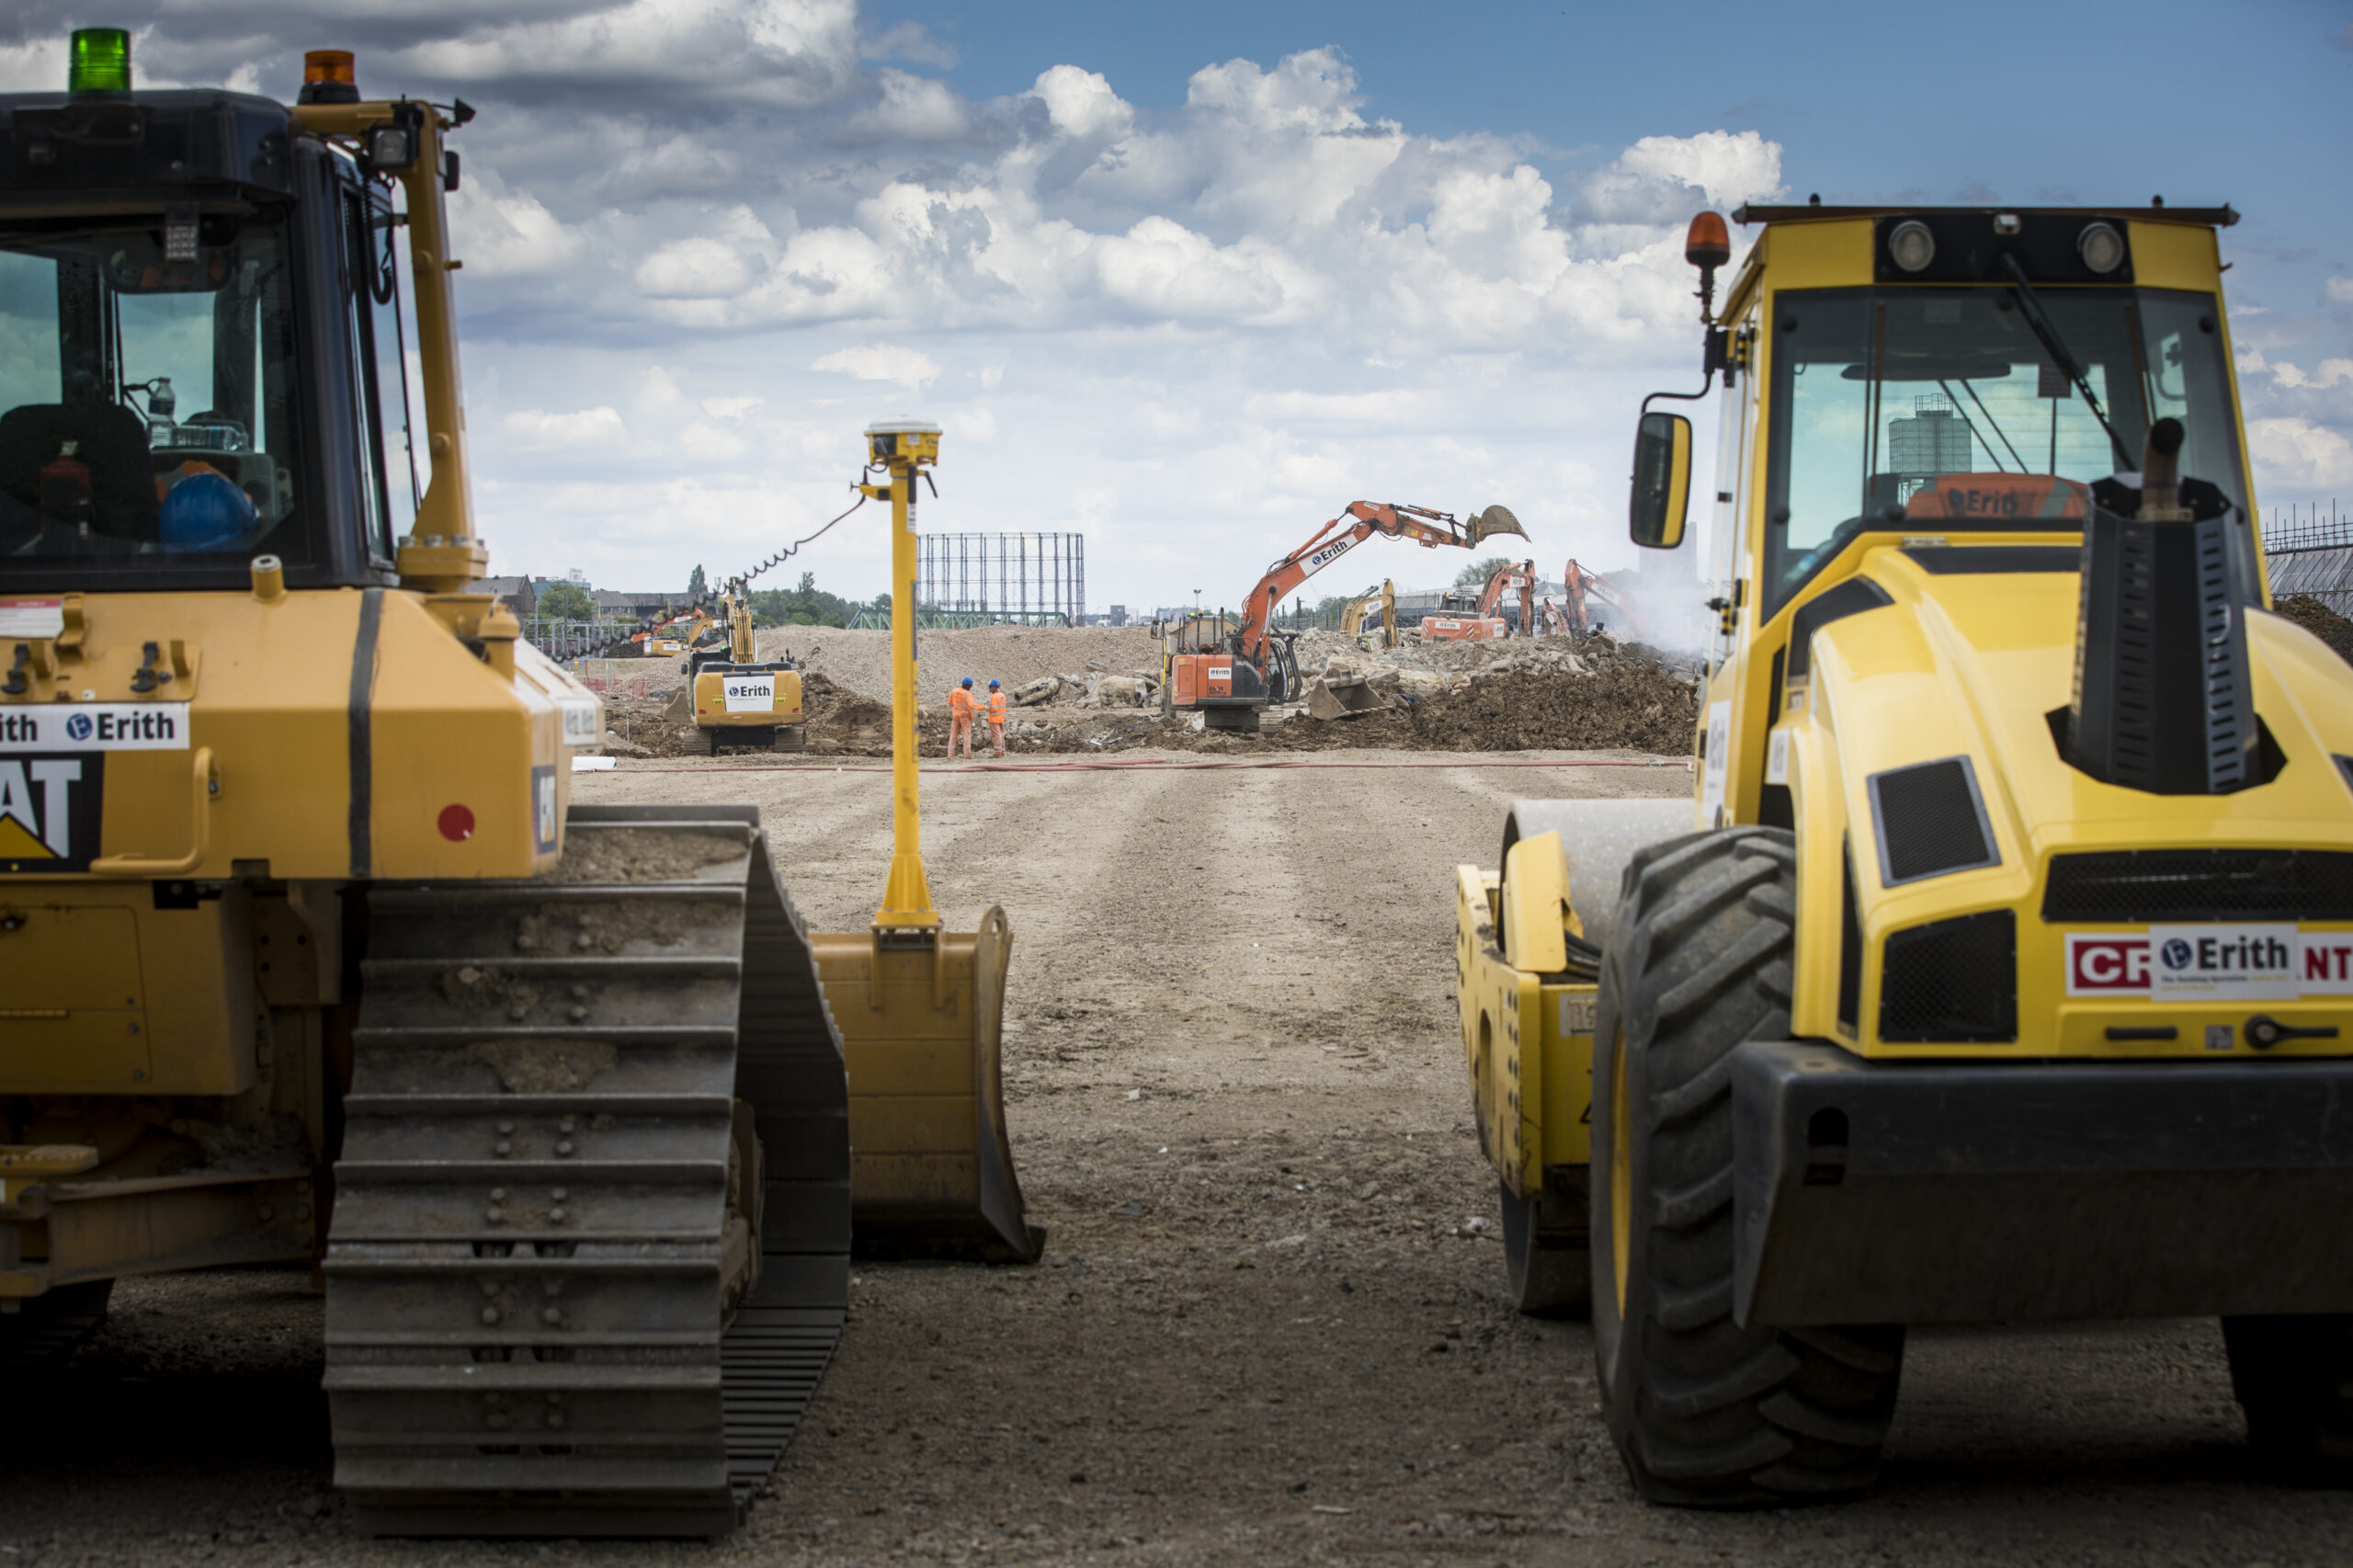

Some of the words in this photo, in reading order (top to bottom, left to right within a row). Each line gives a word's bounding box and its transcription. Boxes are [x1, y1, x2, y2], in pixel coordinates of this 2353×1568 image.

[1321, 540, 1347, 561] Erith
[740, 686, 770, 697] Erith
[97, 711, 175, 740] Erith
[2198, 936, 2288, 970] Erith
